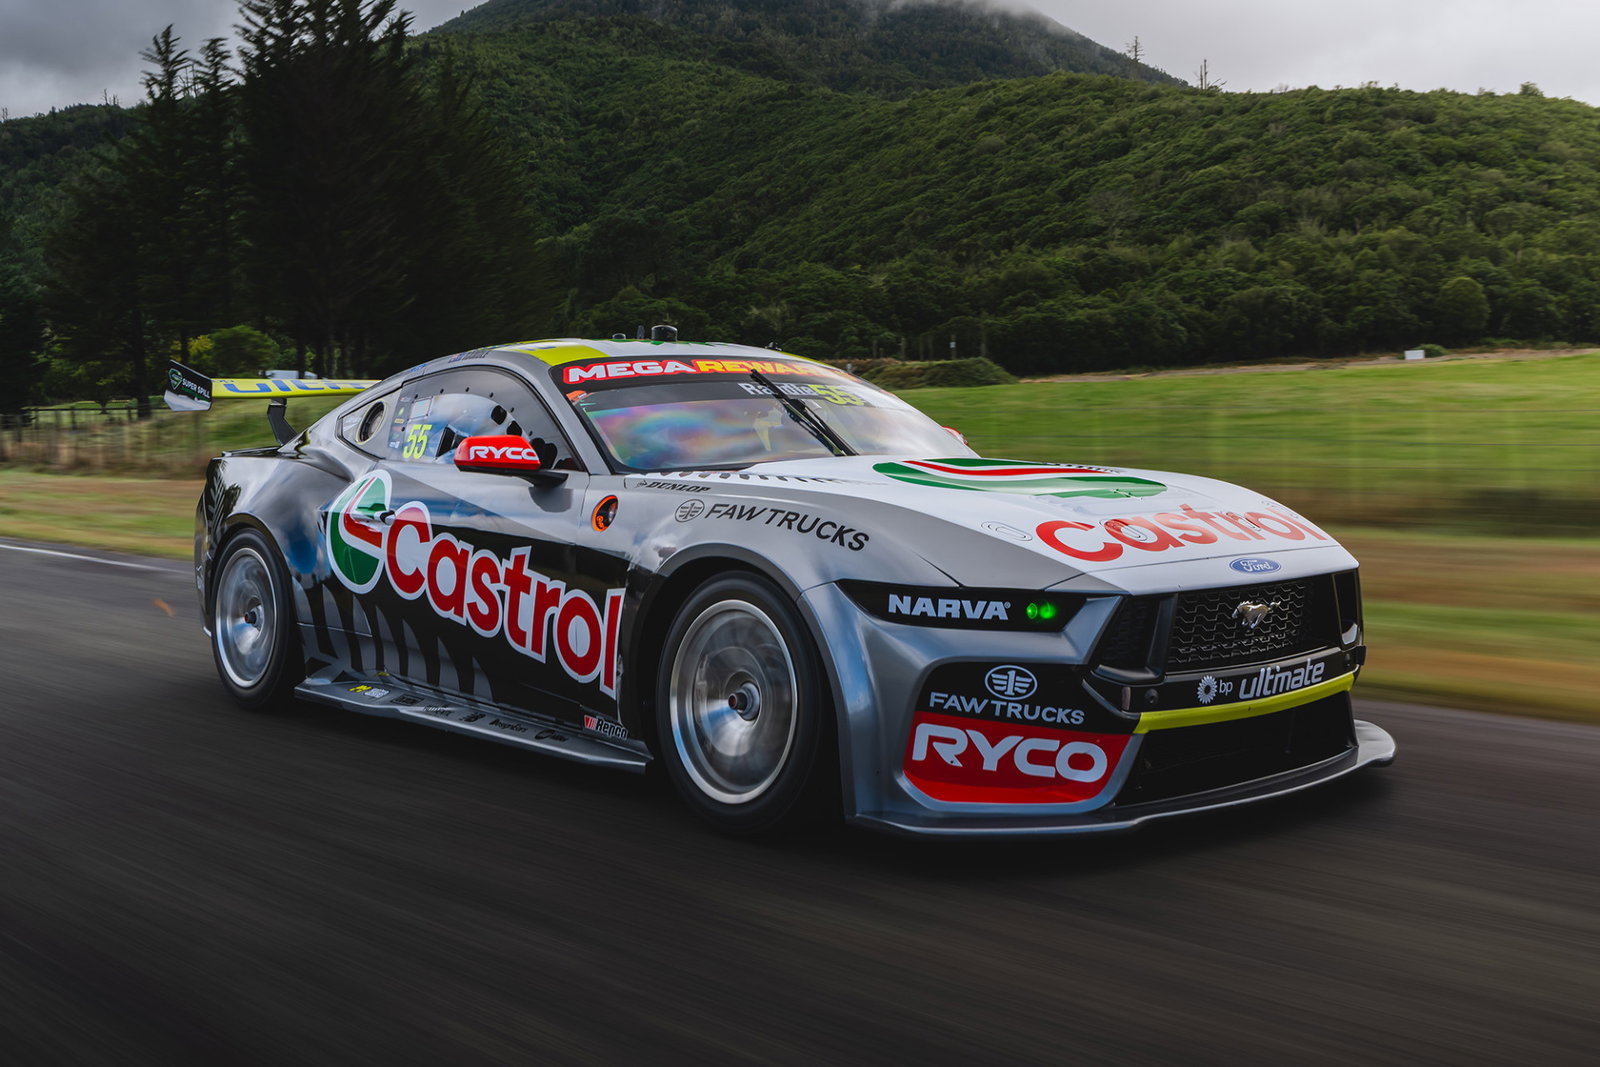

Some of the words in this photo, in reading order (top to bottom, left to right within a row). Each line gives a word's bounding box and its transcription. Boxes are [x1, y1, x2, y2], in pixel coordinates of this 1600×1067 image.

[182, 378, 198, 392] SUPER
[568, 359, 697, 383] MEGA
[808, 384, 865, 406] 55
[403, 423, 432, 460] 55
[645, 481, 712, 493] DUNLOP
[704, 503, 768, 521] FAW
[765, 508, 870, 552] TRUCKS
[1035, 503, 1328, 563] Castrol
[1240, 559, 1274, 572] Ford
[384, 502, 625, 698] Castrol
[1219, 678, 1234, 696] bp
[1238, 657, 1325, 701] ultimate
[928, 691, 990, 714] FAW
[990, 699, 1086, 726] TRUCKS
[596, 717, 629, 740] Repco
[911, 722, 1108, 783] RYCO
